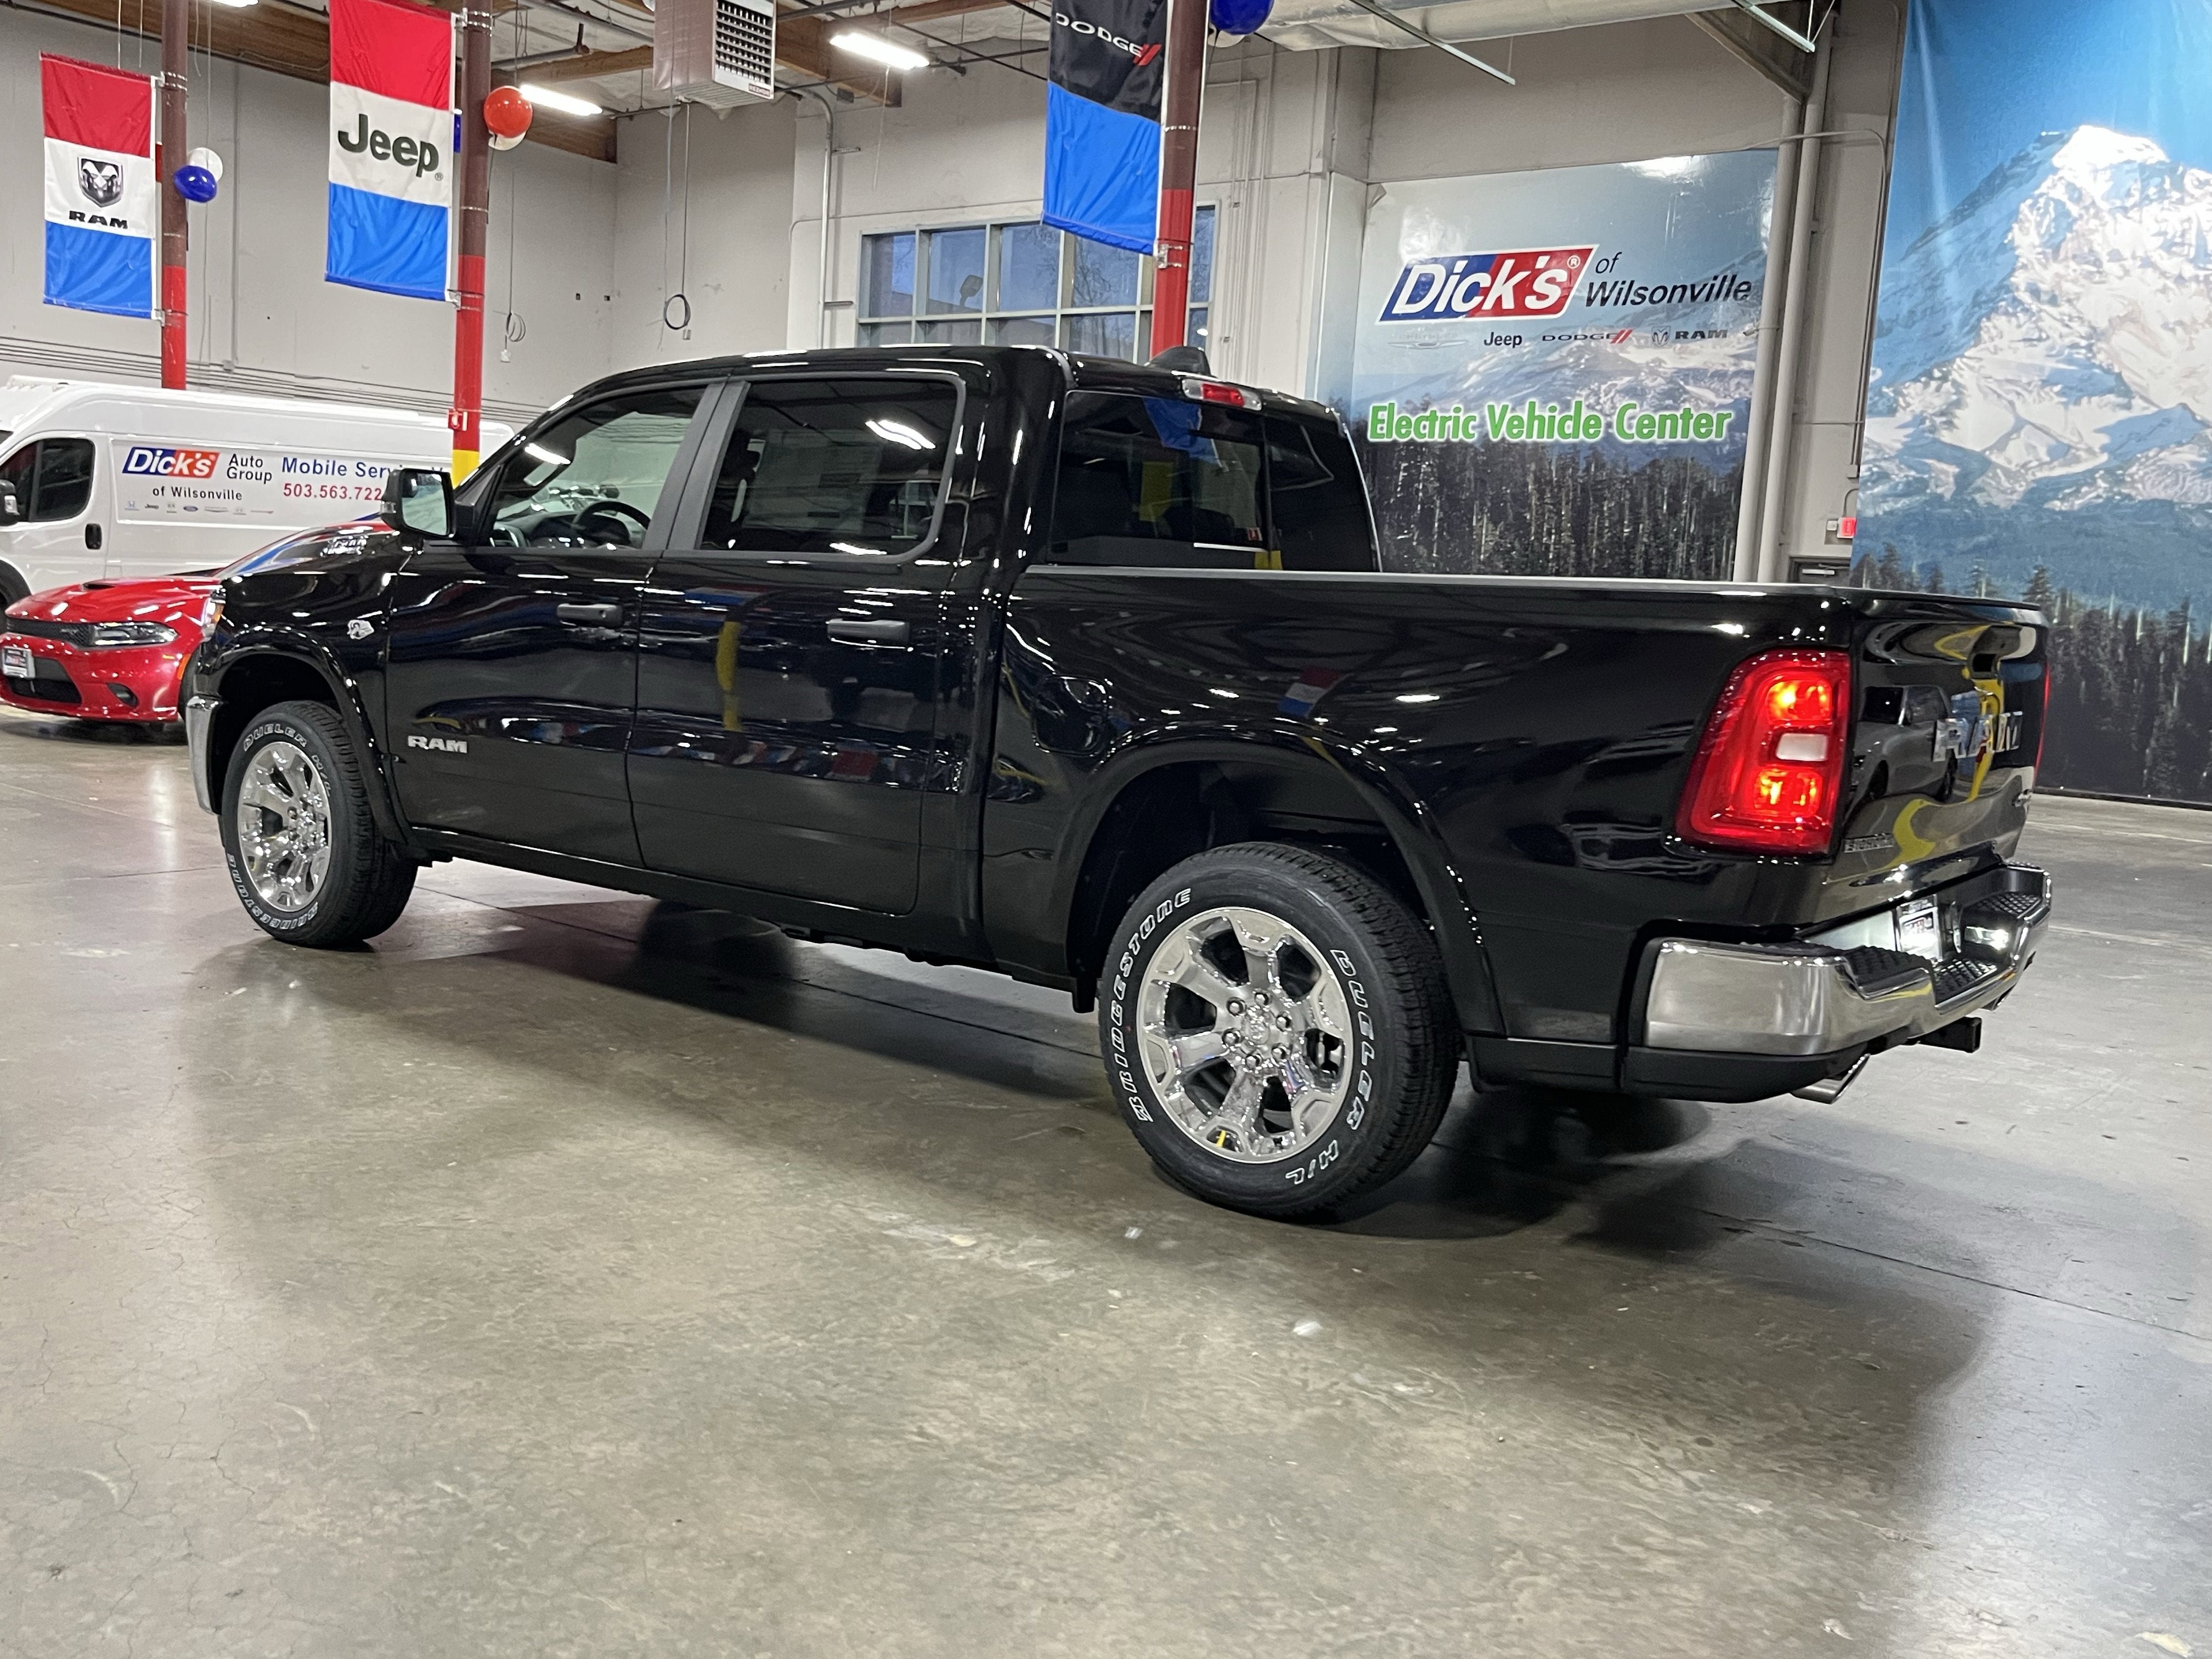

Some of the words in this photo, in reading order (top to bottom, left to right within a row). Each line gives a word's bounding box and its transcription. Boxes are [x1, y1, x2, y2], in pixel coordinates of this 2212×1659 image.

[1056, 13, 1143, 57] DODGE
[338, 114, 439, 178] Jeep
[69, 210, 128, 229] RAM
[1392, 255, 1567, 314] Dick's
[1595, 252, 1622, 274] of
[1585, 275, 1752, 307] Wilsonville
[1483, 331, 1522, 348] Jeep
[1542, 333, 1618, 342] DODGE
[1675, 329, 1728, 340] RAM
[1370, 402, 1477, 441] Electric
[1487, 401, 1602, 441] Vehicle
[1615, 402, 1732, 441] Center
[127, 449, 212, 476] Dick's
[229, 454, 263, 467] Auto
[282, 457, 347, 476] Mobile
[227, 467, 272, 484] Group
[153, 486, 165, 496] of
[171, 486, 242, 500] Wilsonville
[283, 483, 382, 501] 503.563.722
[243, 723, 307, 752] DUELER
[407, 735, 467, 754] RAM
[1110, 888, 1192, 1123] BRIDGESTONE
[1330, 949, 1374, 1130] DUELER
